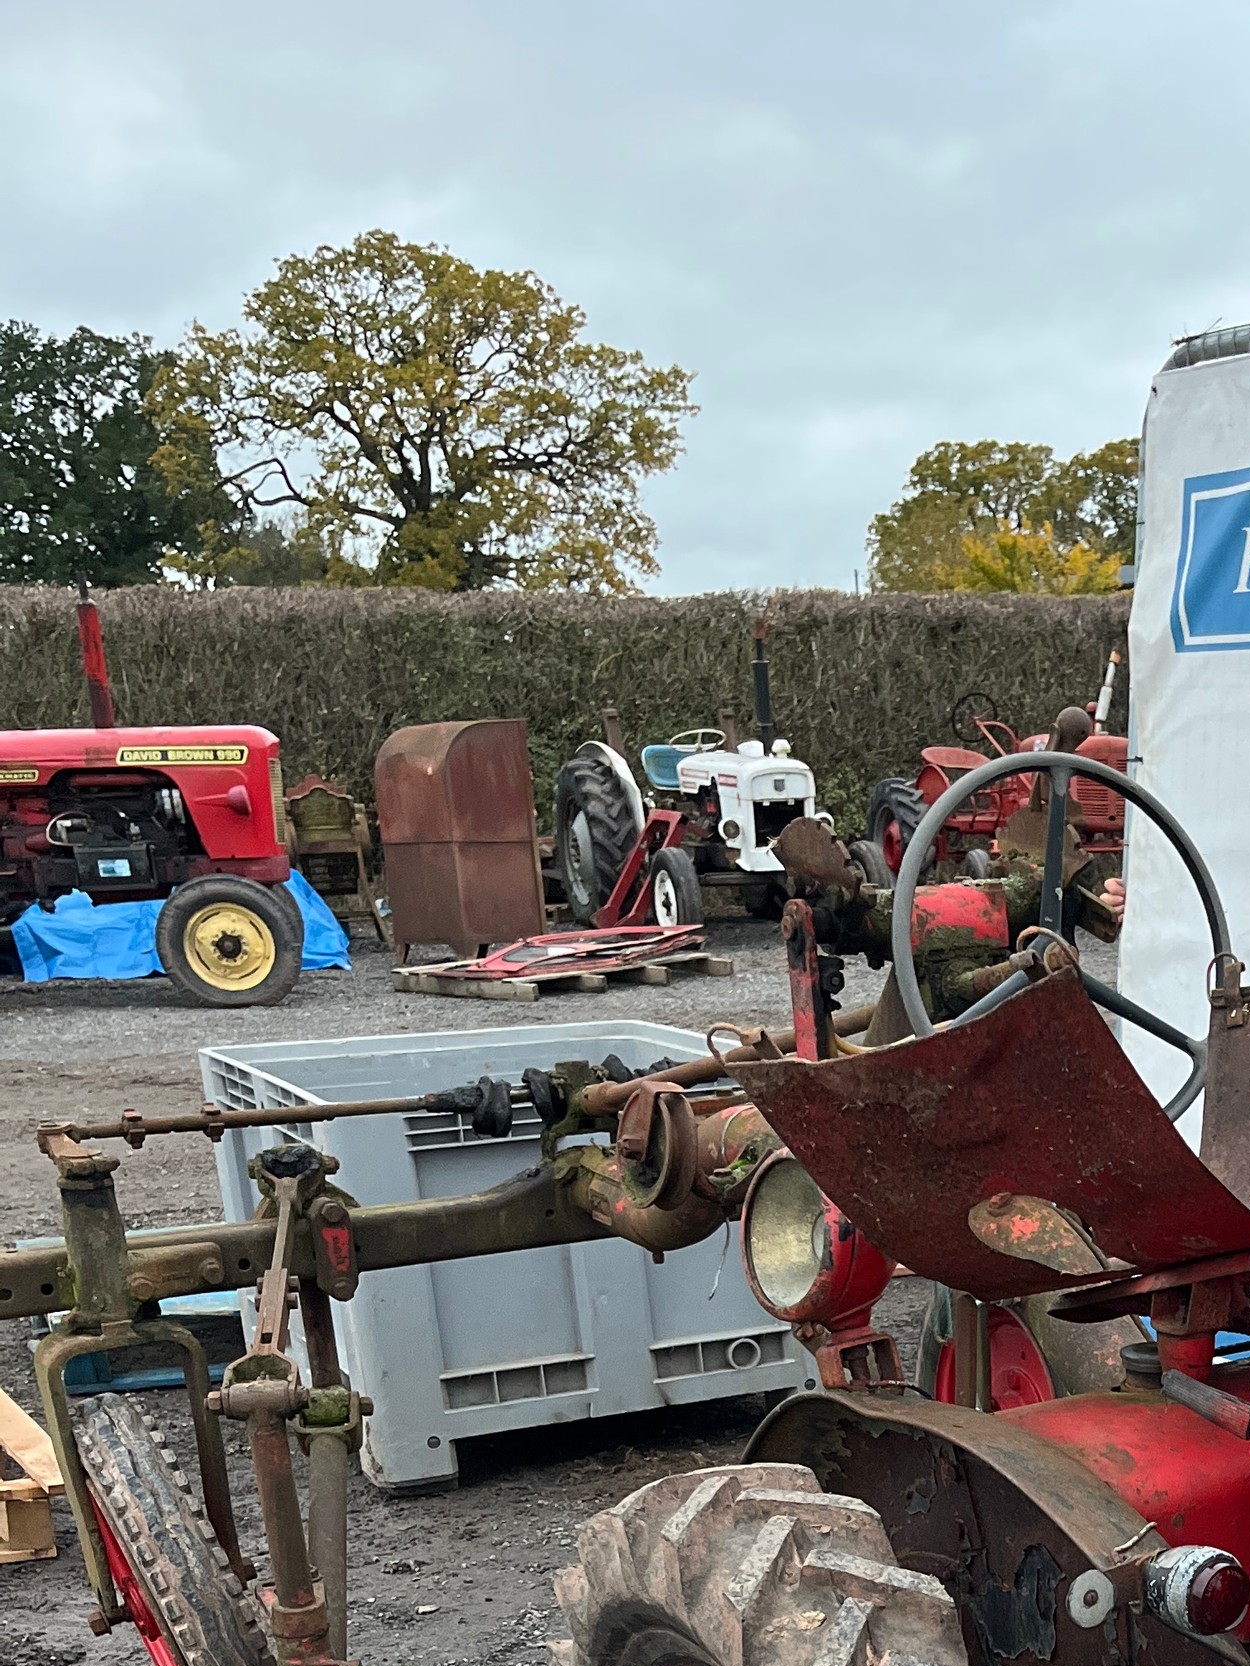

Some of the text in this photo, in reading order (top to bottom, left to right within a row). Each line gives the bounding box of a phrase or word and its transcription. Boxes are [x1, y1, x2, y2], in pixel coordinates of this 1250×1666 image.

[122, 749, 241, 761] DAVID BROWN 990
